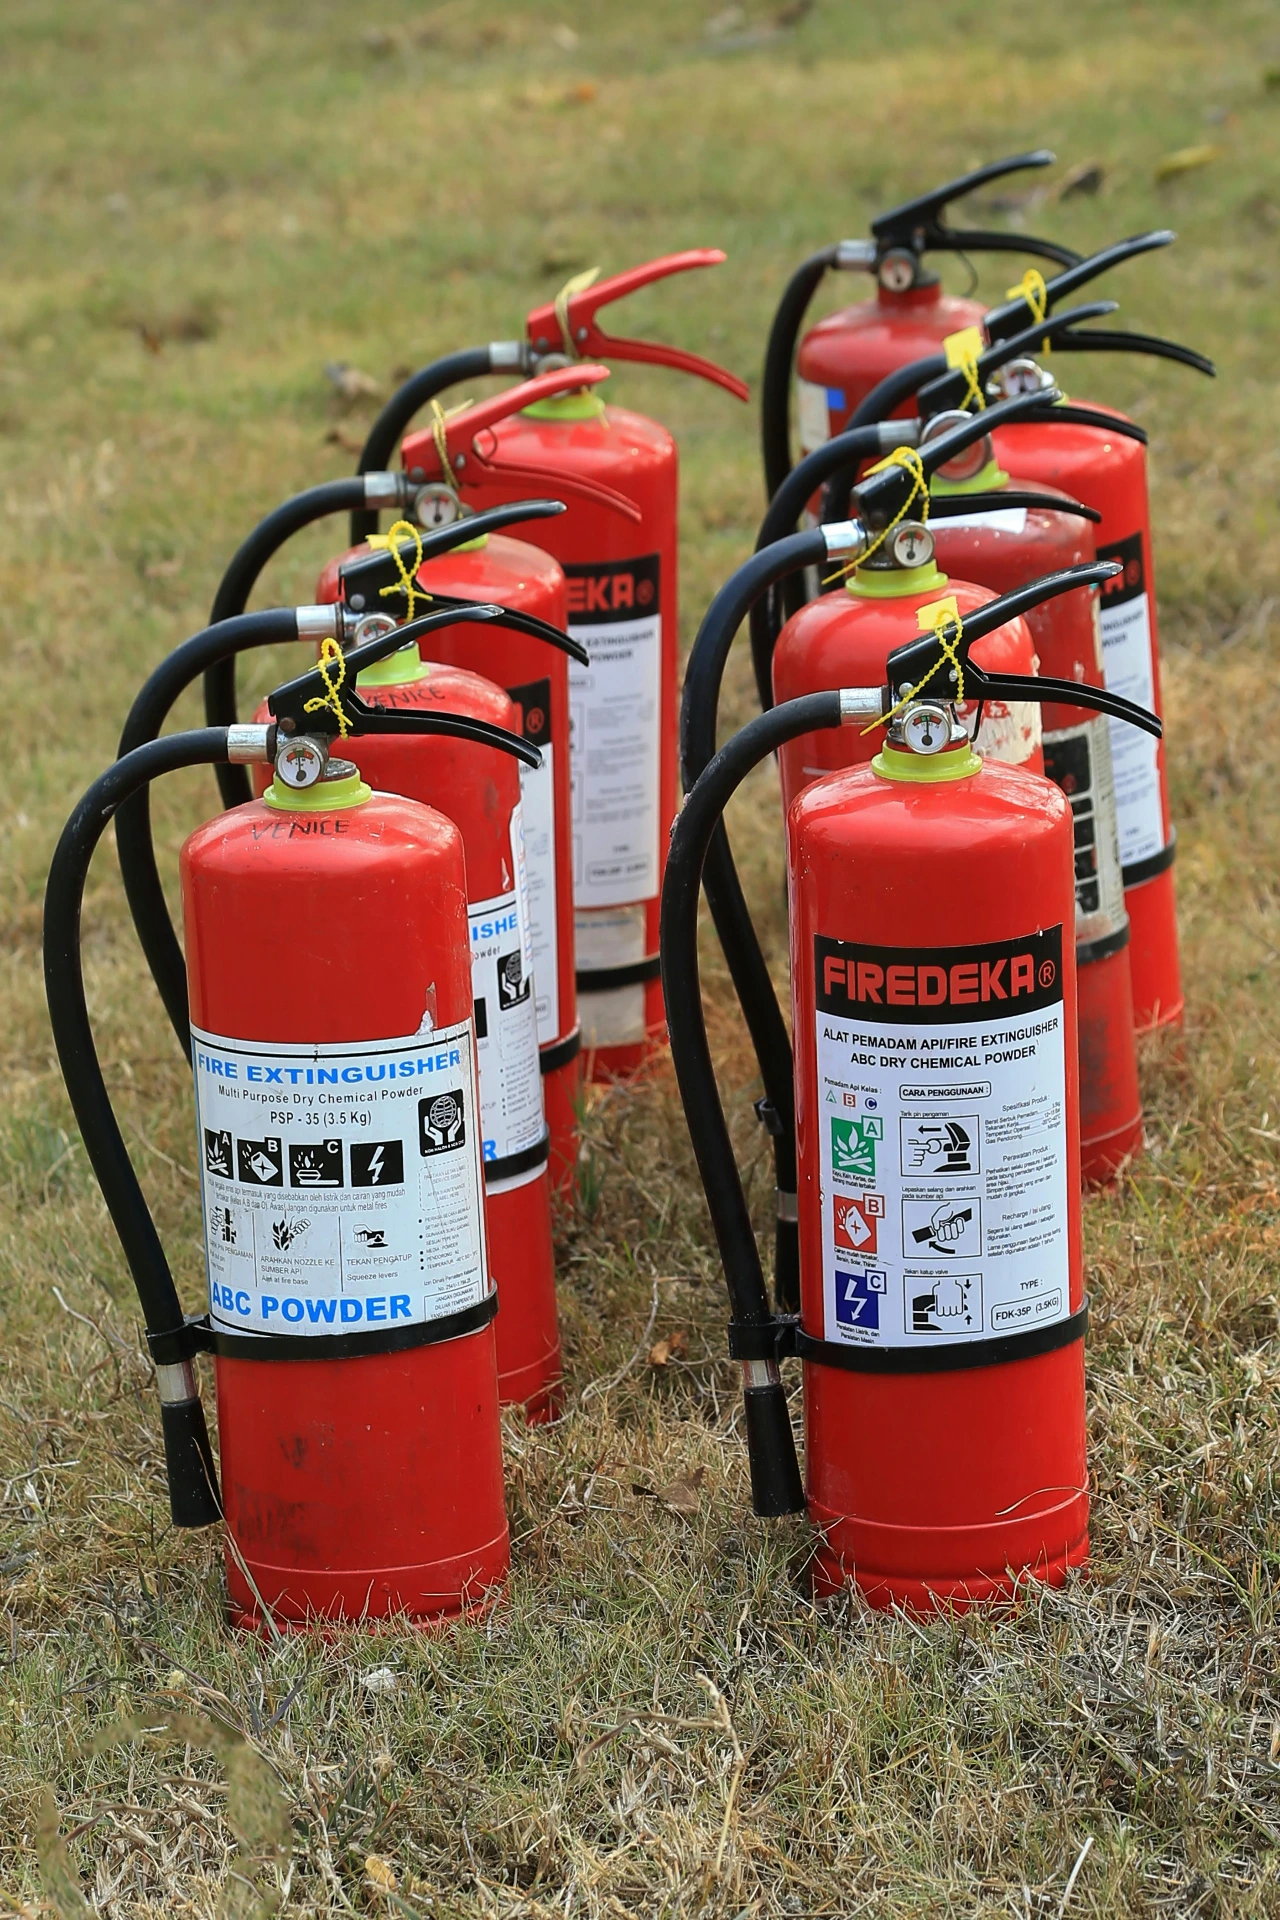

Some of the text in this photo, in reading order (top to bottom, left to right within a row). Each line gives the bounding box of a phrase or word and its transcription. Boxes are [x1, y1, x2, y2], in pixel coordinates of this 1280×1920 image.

[252, 819, 350, 841] VENICE
[823, 953, 1035, 1006] FIREDEKA
[823, 1017, 1059, 1050] ALAT PEMADAM API/FIRE EXTINGUISHER
[850, 1045, 1036, 1069] ABC DRY CHEMICAL POWDER
[198, 1049, 461, 1084] FIRE EXTINGUISHER
[824, 1076, 878, 1093] Pemadam Api Kelas
[902, 1086, 984, 1097] CARA PENGGUNAAN
[218, 1085, 424, 1106] Multi Purpose Dry Chemical Powder
[845, 1095, 855, 1107] B
[1002, 1095, 1048, 1112] Spesifikasi Produk
[270, 1111, 294, 1124] PSP
[305, 1112, 320, 1125] 35
[323, 1111, 346, 1128] (3.5
[350, 1110, 372, 1126] Kg)
[866, 1121, 878, 1136] A
[222, 1133, 339, 1154] A B C
[1002, 1145, 1049, 1162] Perawatan Produk
[357, 1202, 374, 1211] metal
[374, 1201, 387, 1210] fires
[868, 1199, 880, 1213] B
[1001, 1210, 1029, 1221] Recharge
[260, 1255, 293, 1265] ARAHKAN
[294, 1257, 323, 1266] NOZZLE
[346, 1253, 413, 1266] TEKAN PENGATUP
[261, 1266, 302, 1275] SUMBER API
[346, 1271, 398, 1282] Squeeze levers
[291, 1277, 309, 1286] base
[870, 1275, 881, 1289] C
[1019, 1278, 1039, 1290] TYPE
[212, 1281, 252, 1316] ABC
[261, 1294, 413, 1323] POWDER
[995, 1296, 1059, 1320] FDK-35P (3.5KG)
